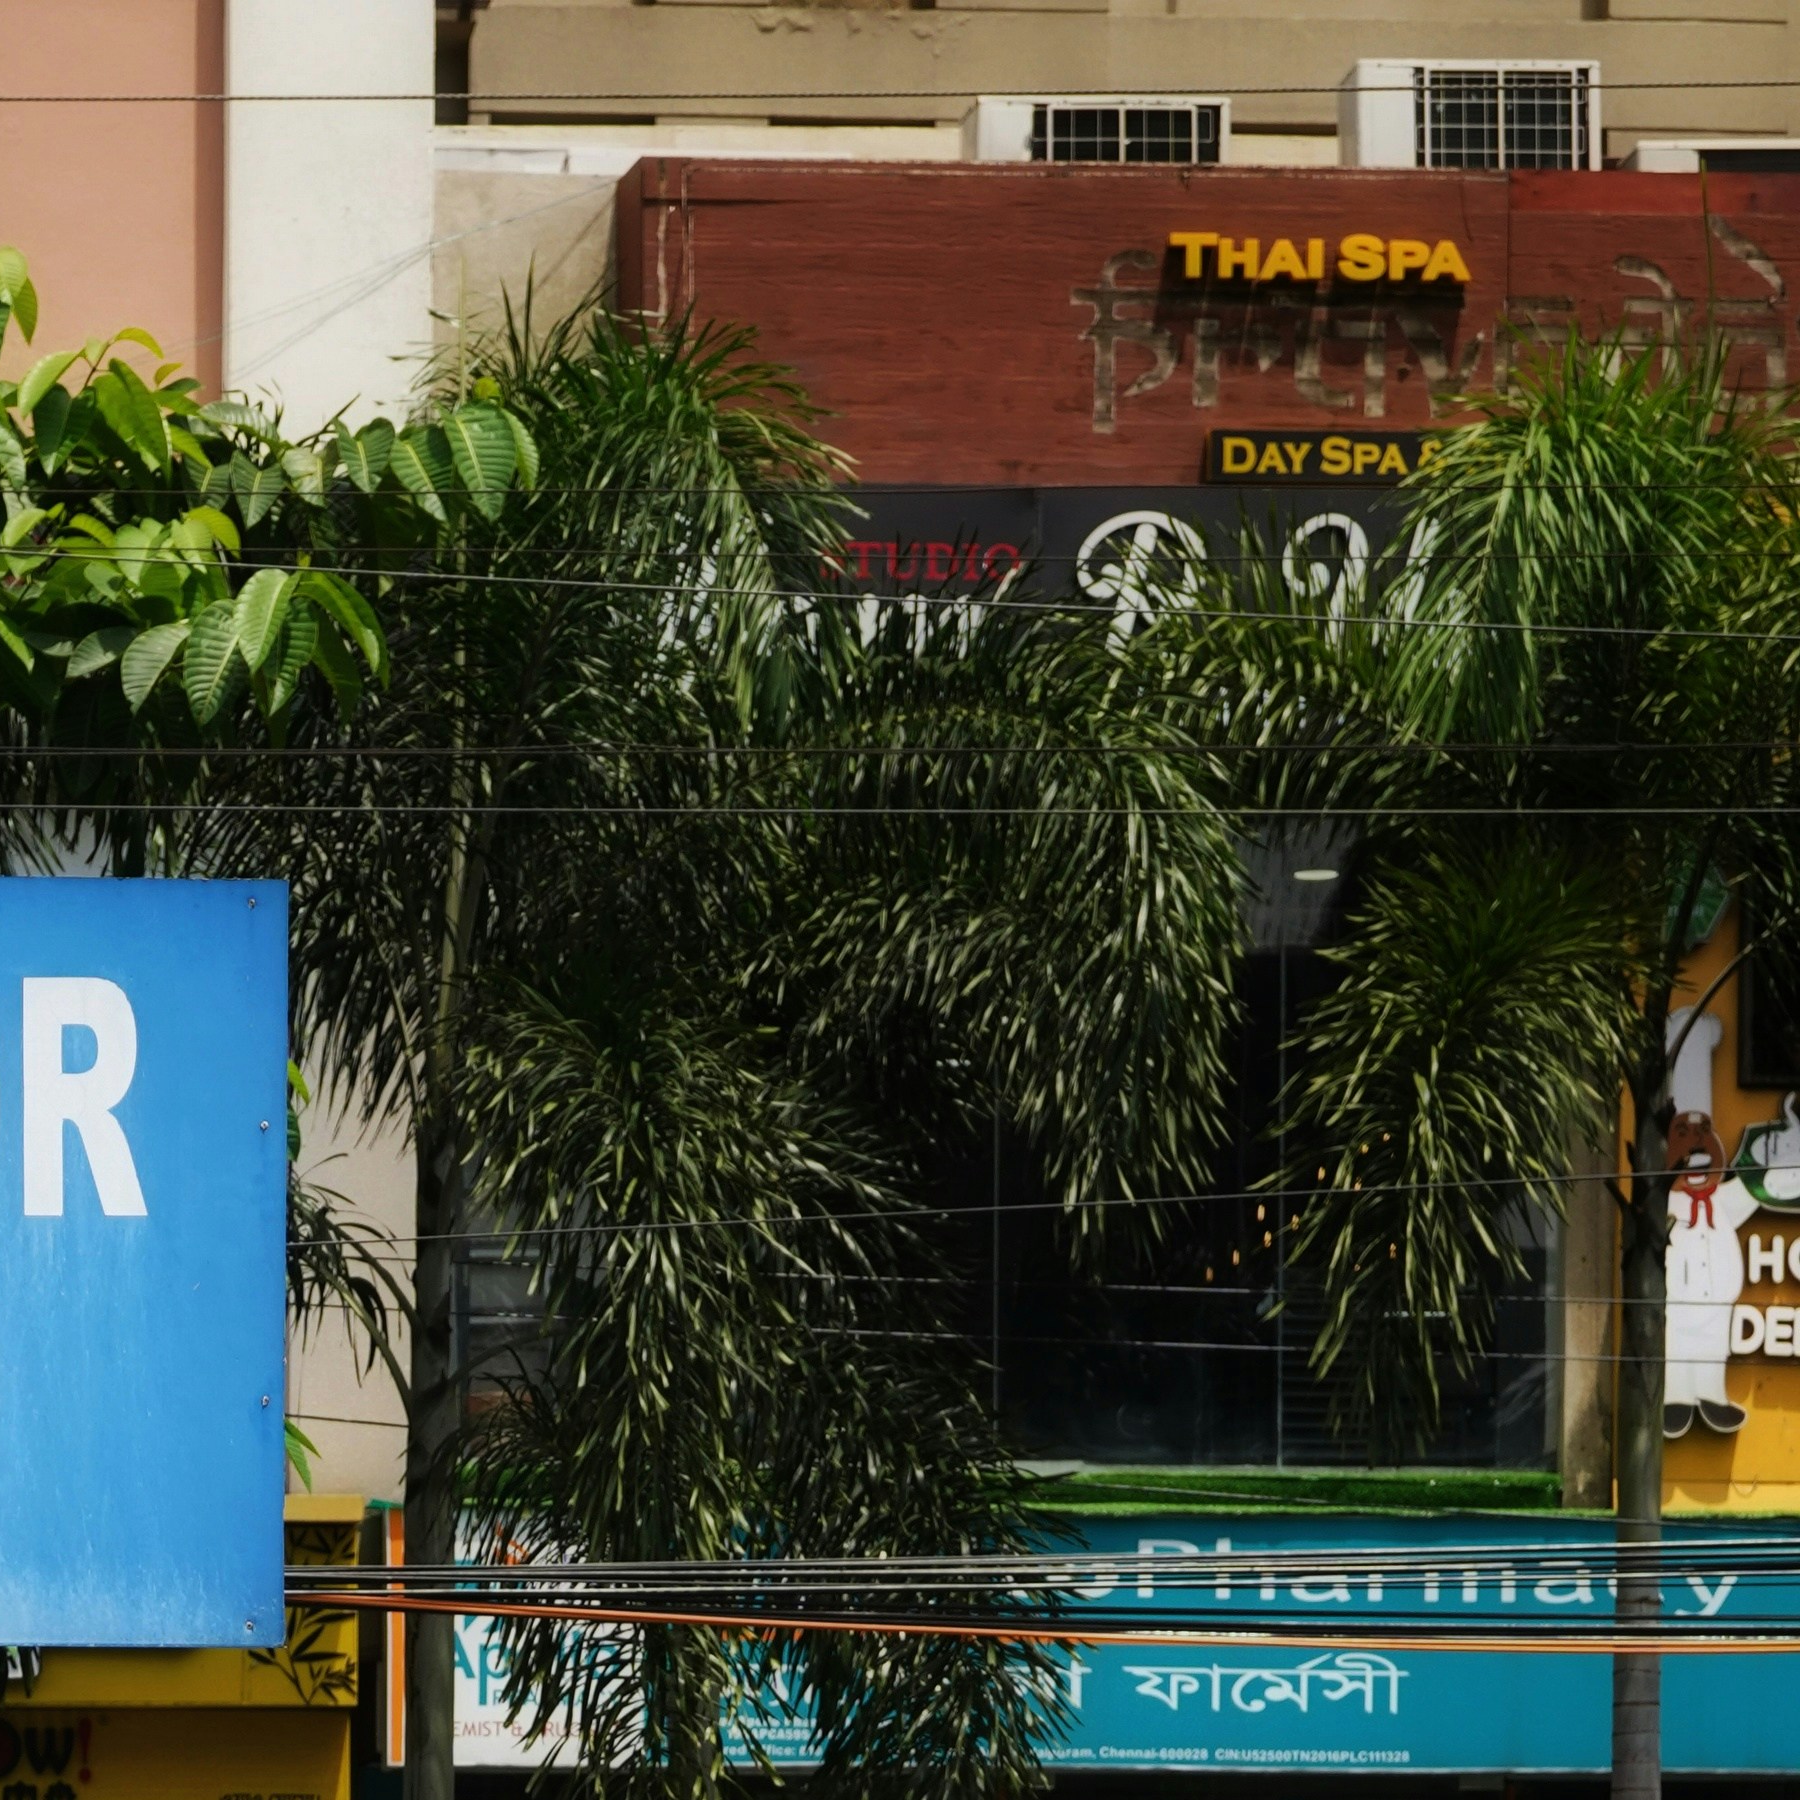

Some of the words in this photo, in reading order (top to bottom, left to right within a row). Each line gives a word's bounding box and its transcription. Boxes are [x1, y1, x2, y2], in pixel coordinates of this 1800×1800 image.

[1168, 232, 1325, 283] THAI
[1336, 232, 1472, 283] SPA
[1220, 436, 1310, 475] DAY
[1319, 436, 1407, 476] SPA
[1748, 1232, 1800, 1286] H
[1730, 1304, 1800, 1358] DE
[1136, 1537, 1740, 1618] Pharmay
[1121, 1652, 1410, 1715] ফার্মেসী
[453, 1720, 503, 1738] EMIST
